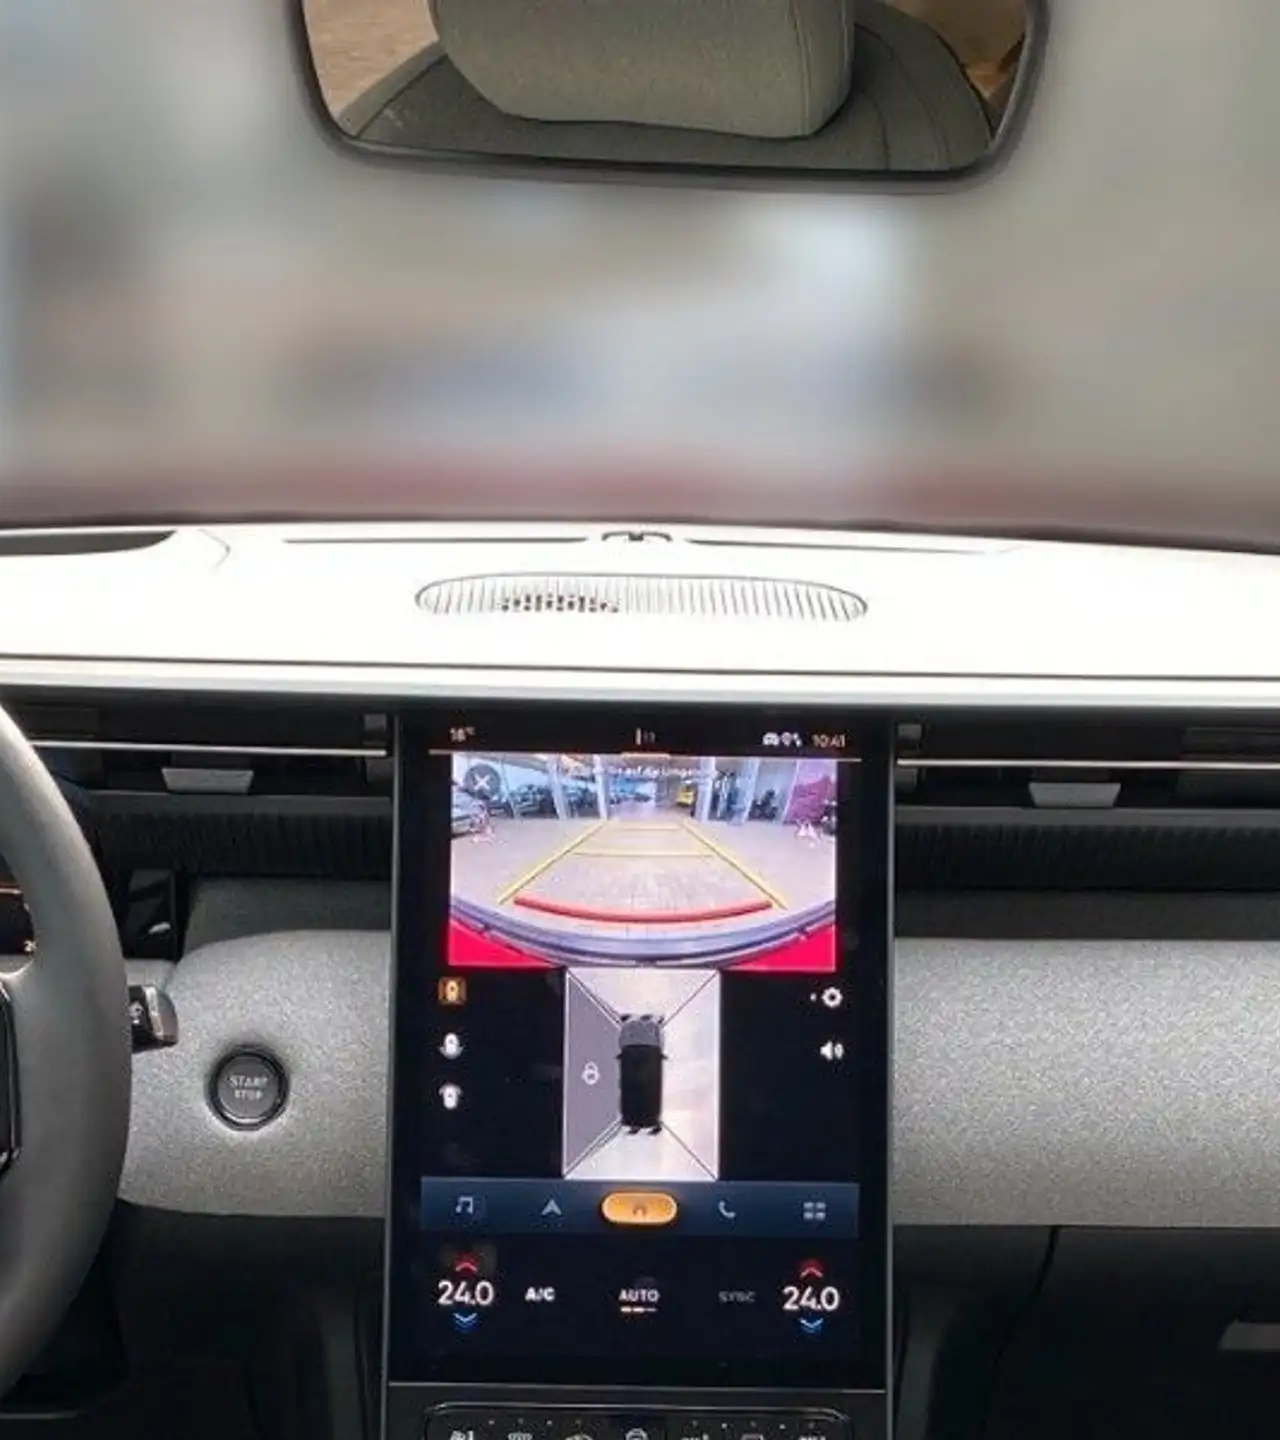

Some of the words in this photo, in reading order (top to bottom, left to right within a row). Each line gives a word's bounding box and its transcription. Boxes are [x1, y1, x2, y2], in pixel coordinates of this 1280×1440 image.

[229, 1075, 268, 1087] START
[437, 1280, 494, 1305] 24.0
[524, 1287, 555, 1302] A/C
[618, 1288, 660, 1303] AUTO
[782, 1285, 840, 1311] 24.0
